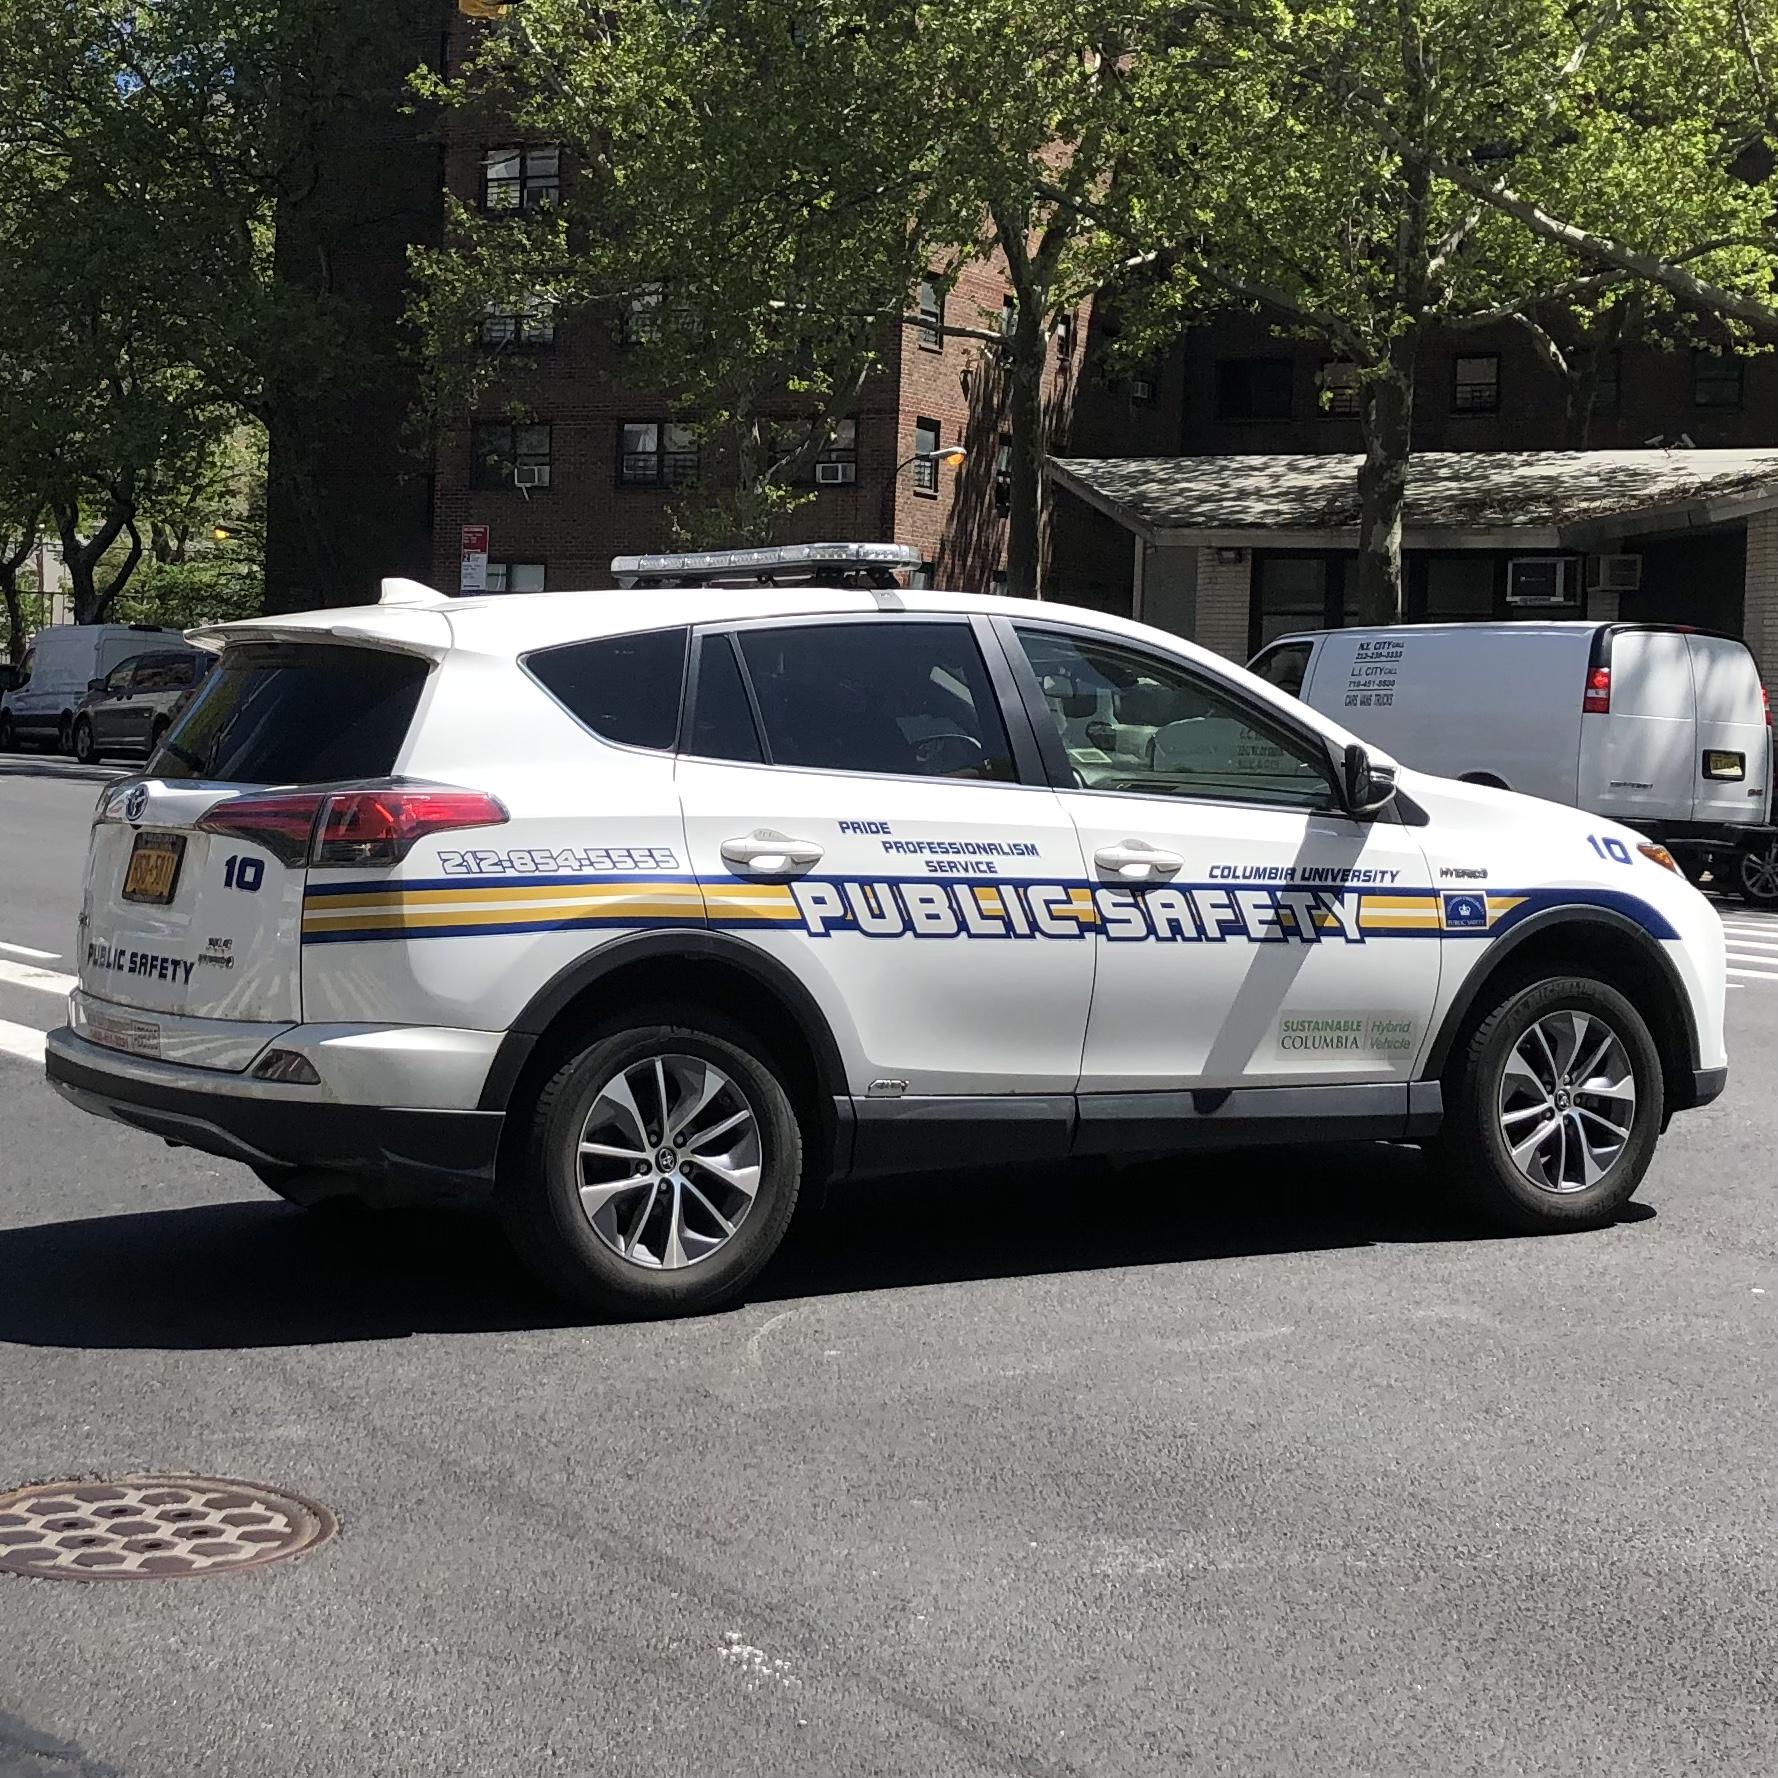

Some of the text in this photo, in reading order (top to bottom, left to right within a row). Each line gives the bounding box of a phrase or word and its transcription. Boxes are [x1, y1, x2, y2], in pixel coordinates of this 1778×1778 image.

[1374, 641, 1392, 650] CITY
[1365, 667, 1384, 676] CITY
[838, 821, 891, 834] PRIDE
[882, 841, 1039, 856] PROFESSIONALISM
[1587, 834, 1633, 865] 10
[438, 848, 679, 874] 212-854-5555
[925, 861, 997, 873] SERVICE
[225, 855, 264, 891] 10
[1209, 866, 1400, 883] COLUMBIA UNIVERSITY
[789, 881, 1367, 943] PUBLIC SAFETY
[87, 943, 126, 971] PUBLIC
[128, 952, 194, 985] SAFETY
[1283, 1020, 1362, 1032] SUSTAINABLE
[1371, 1020, 1412, 1035] Hybrid
[1281, 1035, 1359, 1049] COLUMBIA
[1370, 1037, 1411, 1049] Vehicle
